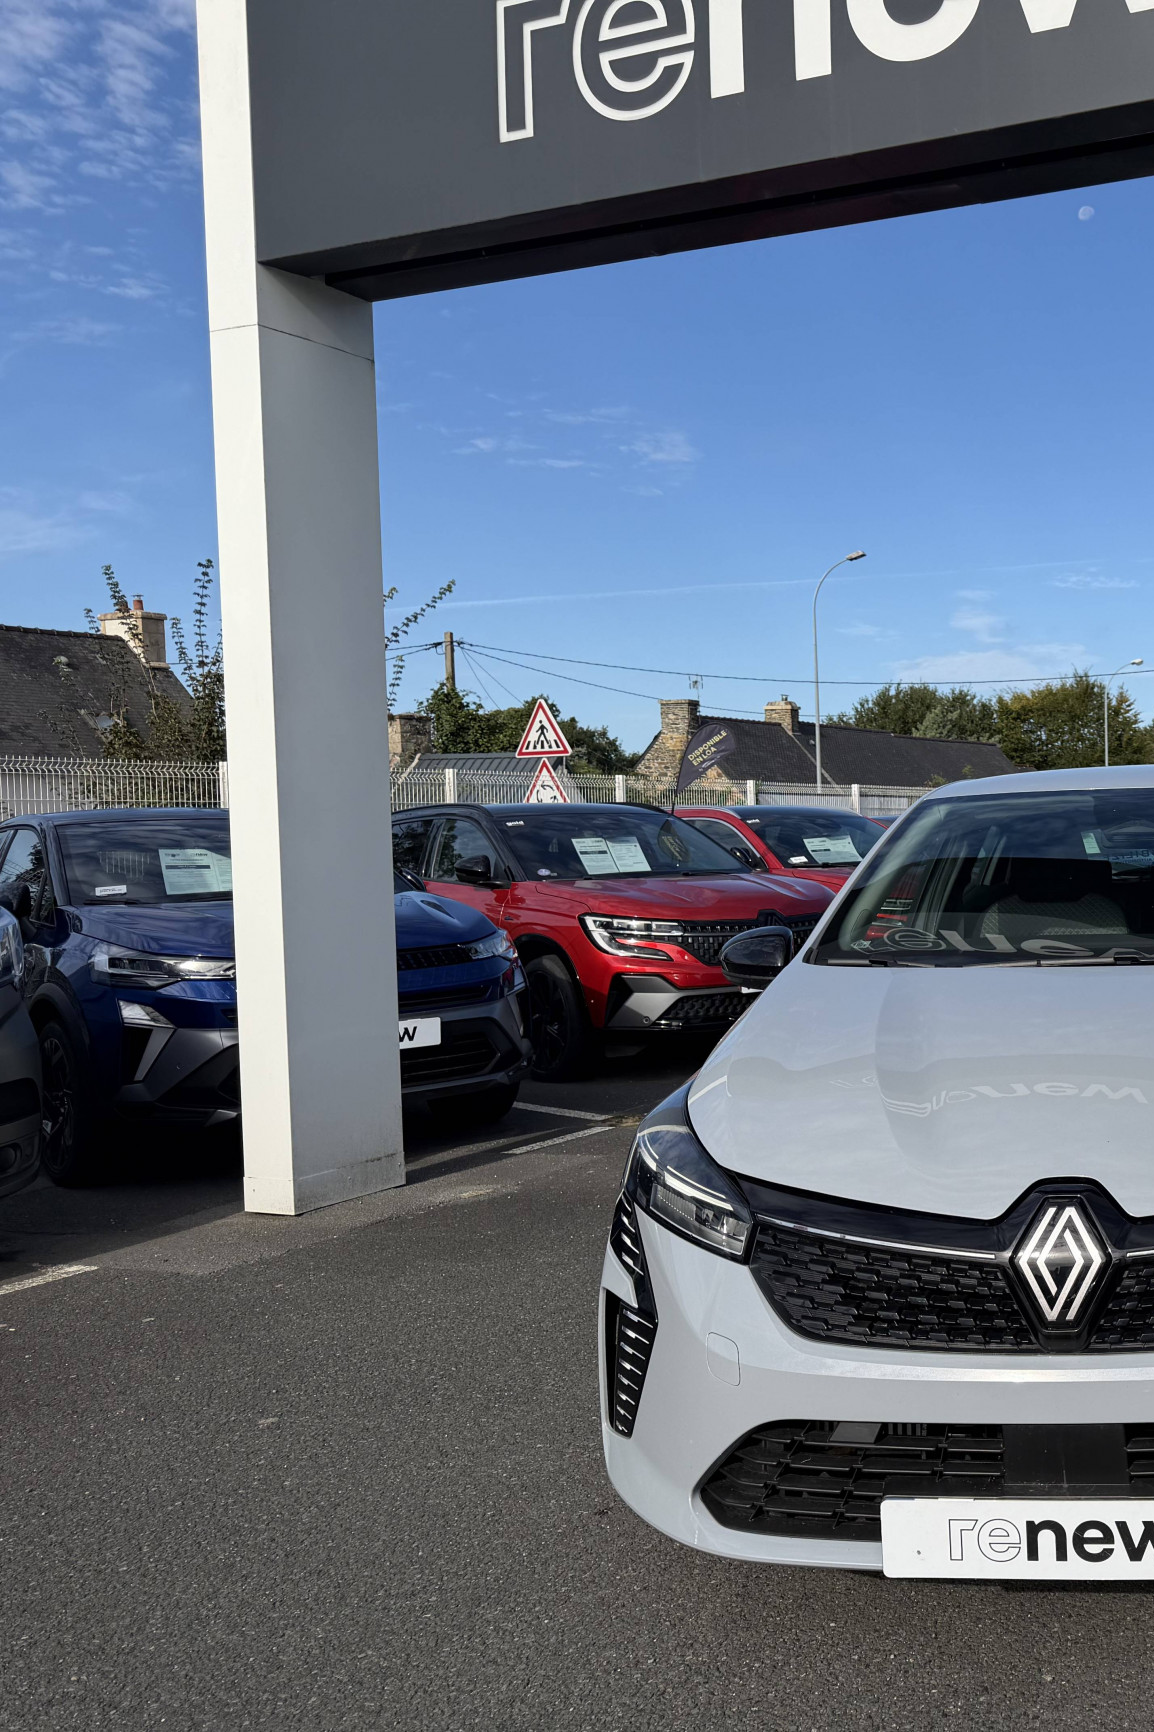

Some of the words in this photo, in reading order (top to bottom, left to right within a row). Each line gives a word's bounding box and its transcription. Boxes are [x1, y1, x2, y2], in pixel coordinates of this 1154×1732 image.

[687, 729, 728, 761] DISPONIBLE
[692, 756, 704, 766] EN
[701, 746, 718, 760] LOA
